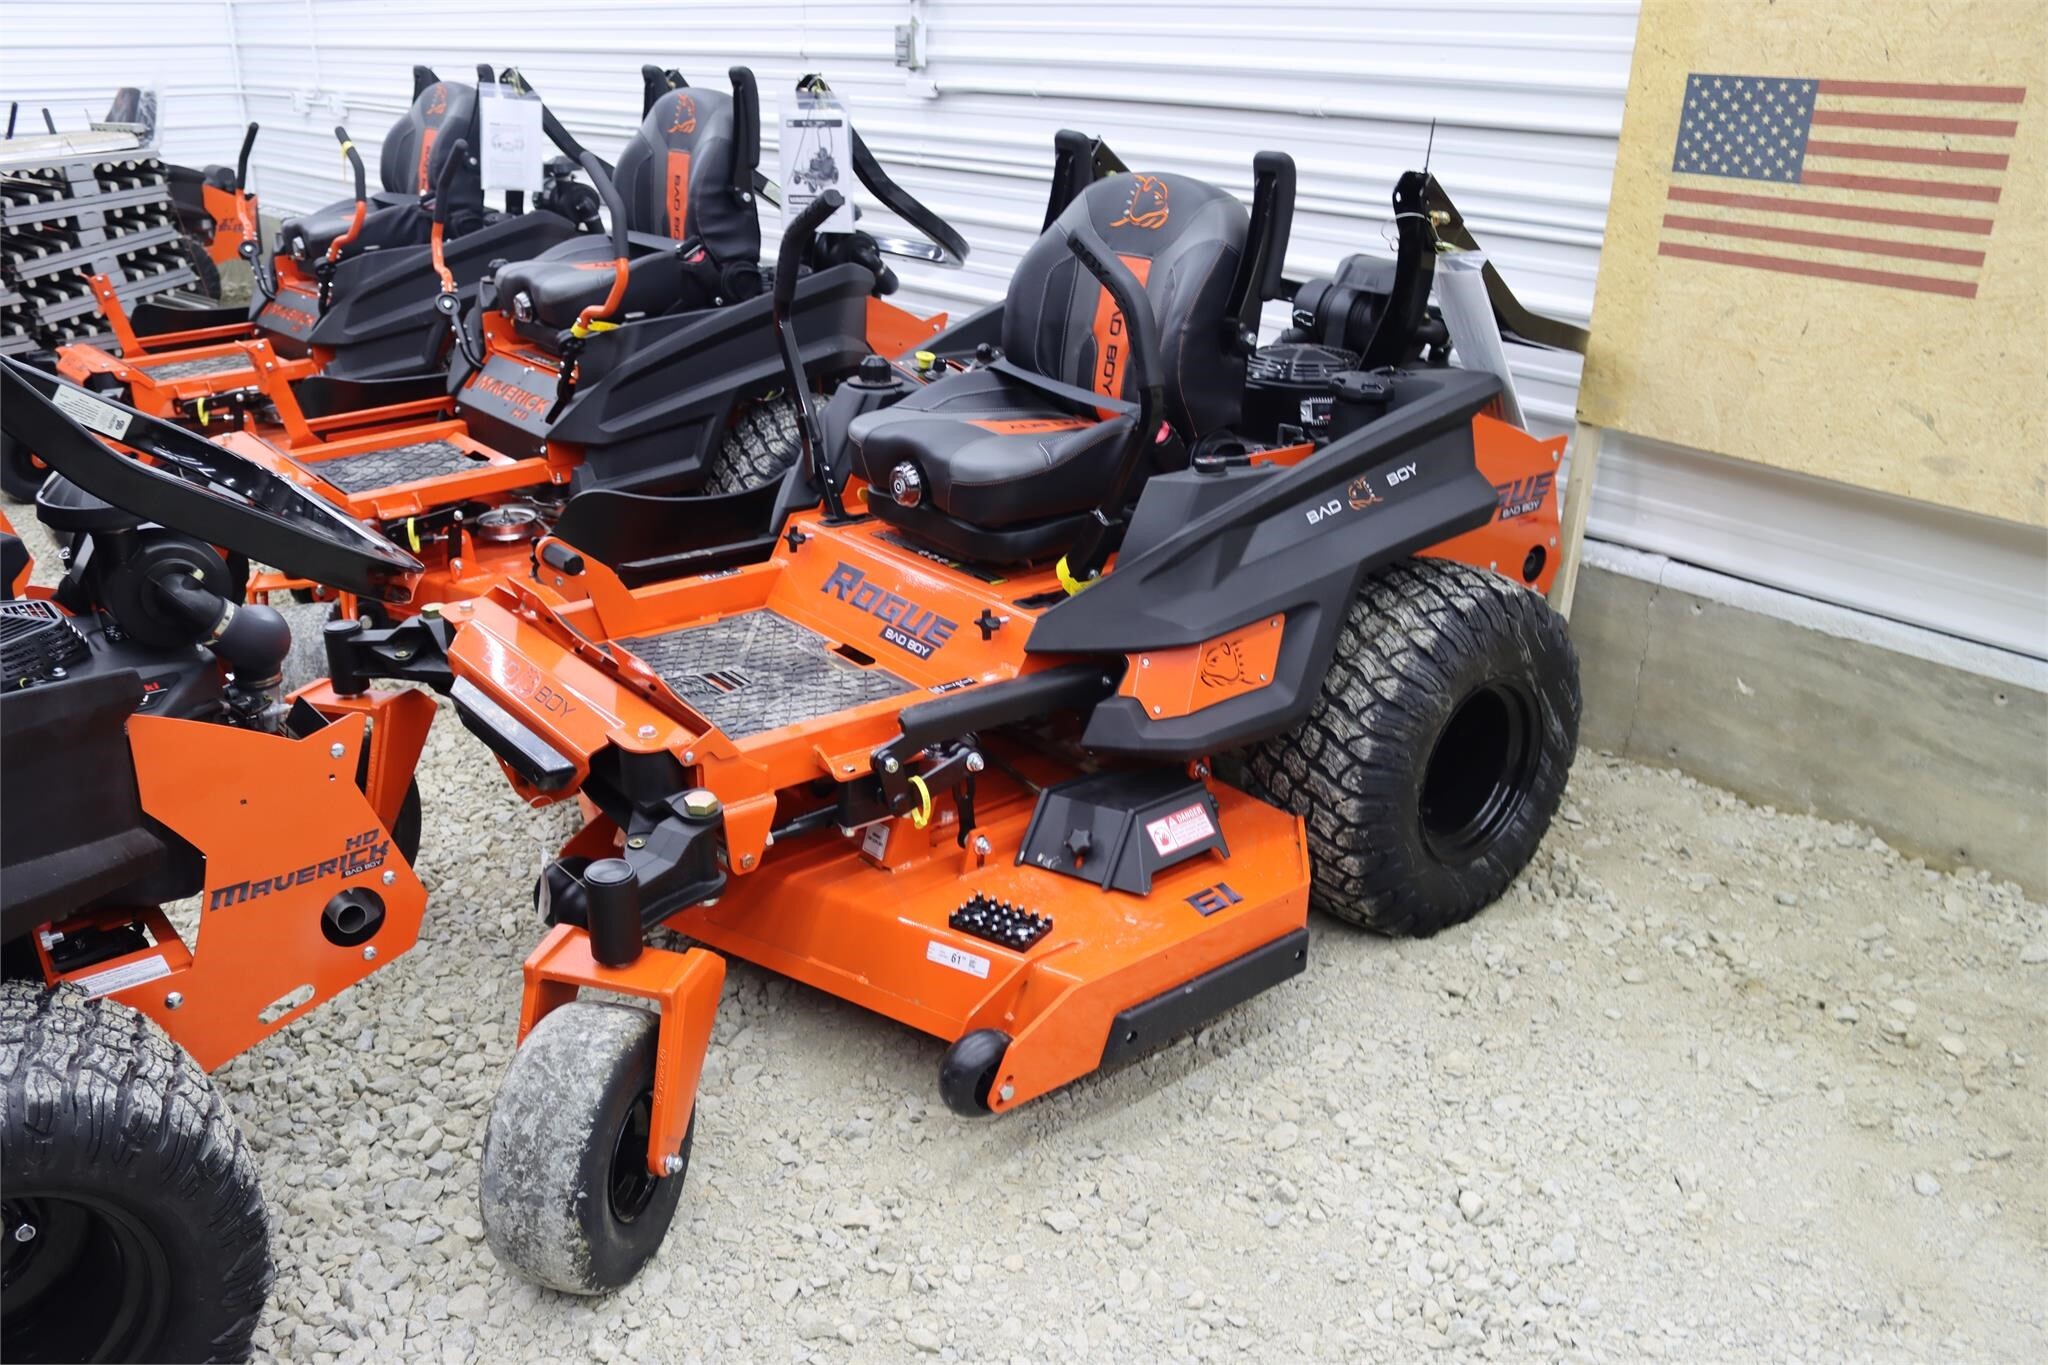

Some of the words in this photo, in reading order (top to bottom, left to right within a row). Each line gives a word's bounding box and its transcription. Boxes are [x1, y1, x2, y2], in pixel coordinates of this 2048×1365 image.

[476, 375, 551, 415] MAVERICK
[1306, 499, 1342, 525] BAD
[1386, 461, 1417, 487] BOY
[1496, 471, 1553, 508] GUE
[1502, 507, 1521, 519] BAD
[1521, 500, 1540, 513] BOY
[885, 627, 906, 647] BAD
[906, 638, 930, 657] BOY
[534, 686, 576, 718] BOY
[1175, 804, 1204, 824] DANGER
[345, 828, 380, 851] HD
[344, 866, 363, 877] BAD
[364, 859, 382, 871] BOY
[1184, 882, 1243, 918] 61
